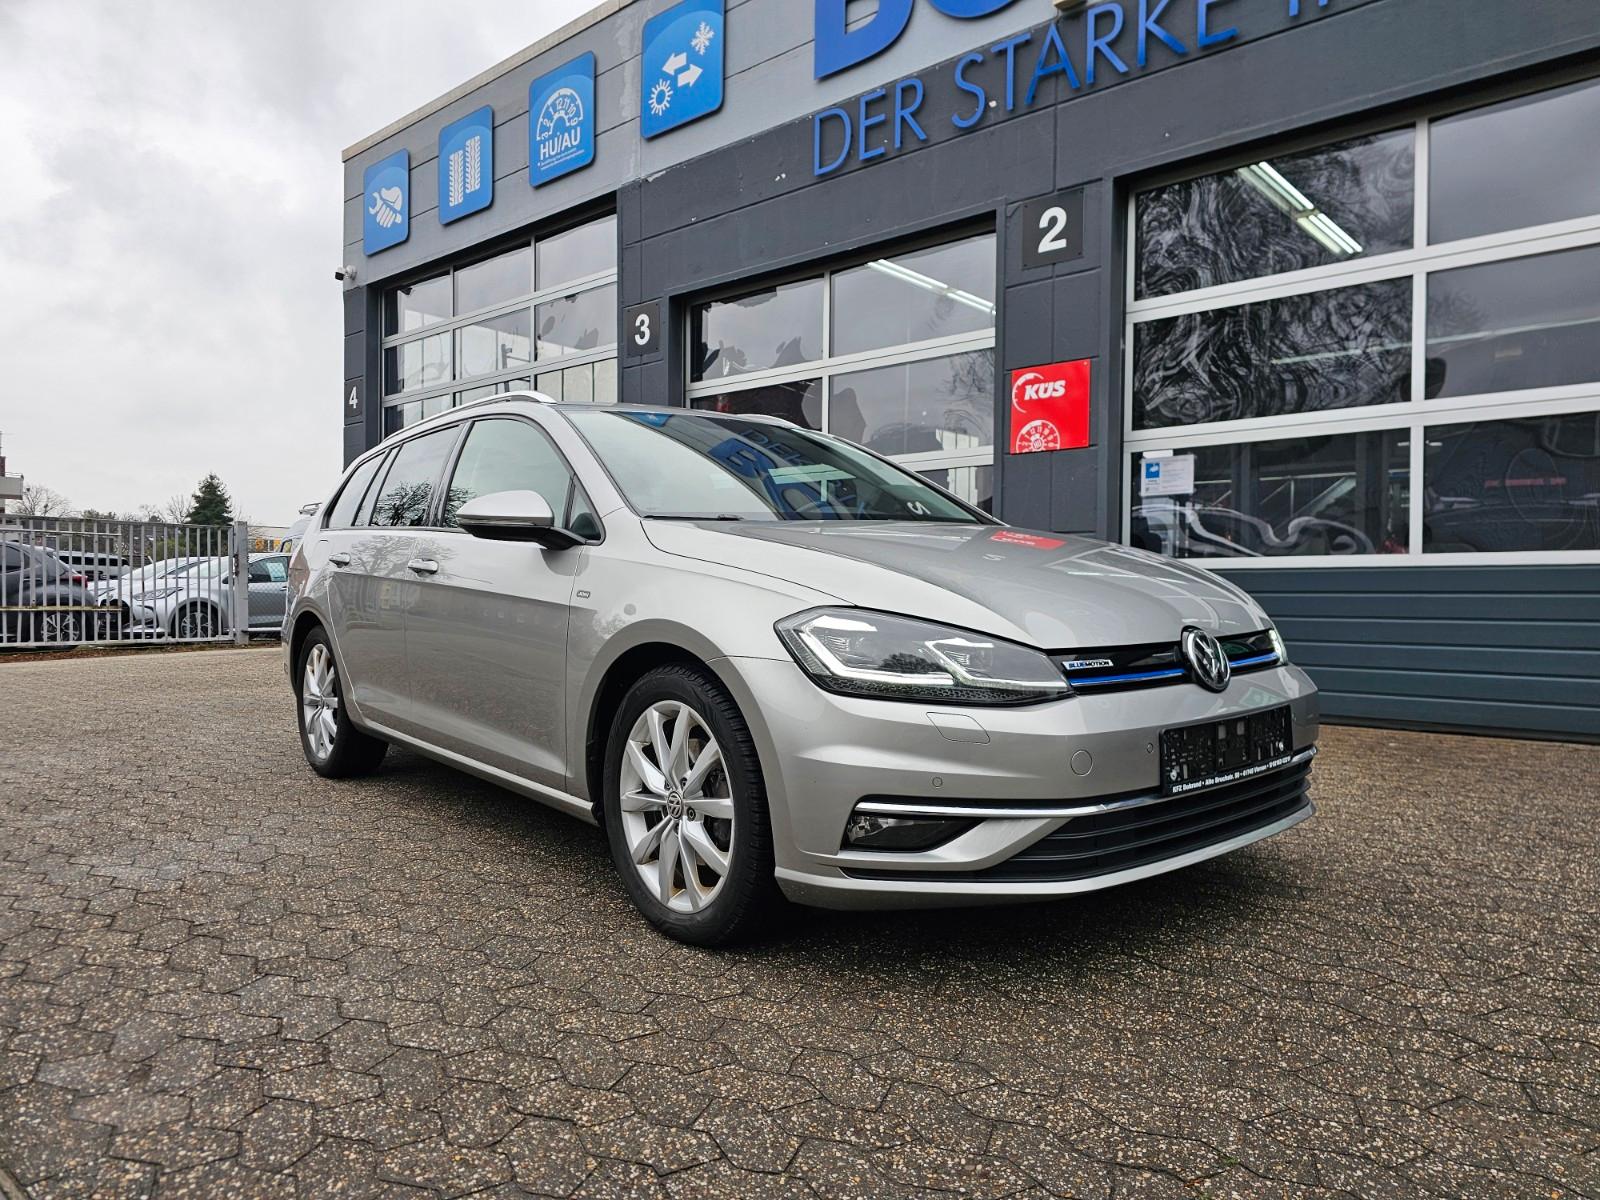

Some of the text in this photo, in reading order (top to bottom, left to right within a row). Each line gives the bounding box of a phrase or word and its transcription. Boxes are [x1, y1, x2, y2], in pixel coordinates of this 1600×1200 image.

[814, 77, 927, 176] DER
[540, 126, 581, 161] HU/AU
[1037, 206, 1067, 254] 2
[634, 313, 650, 345] 3
[349, 385, 358, 409] 4
[1068, 660, 1110, 668] BLUEMOTION
